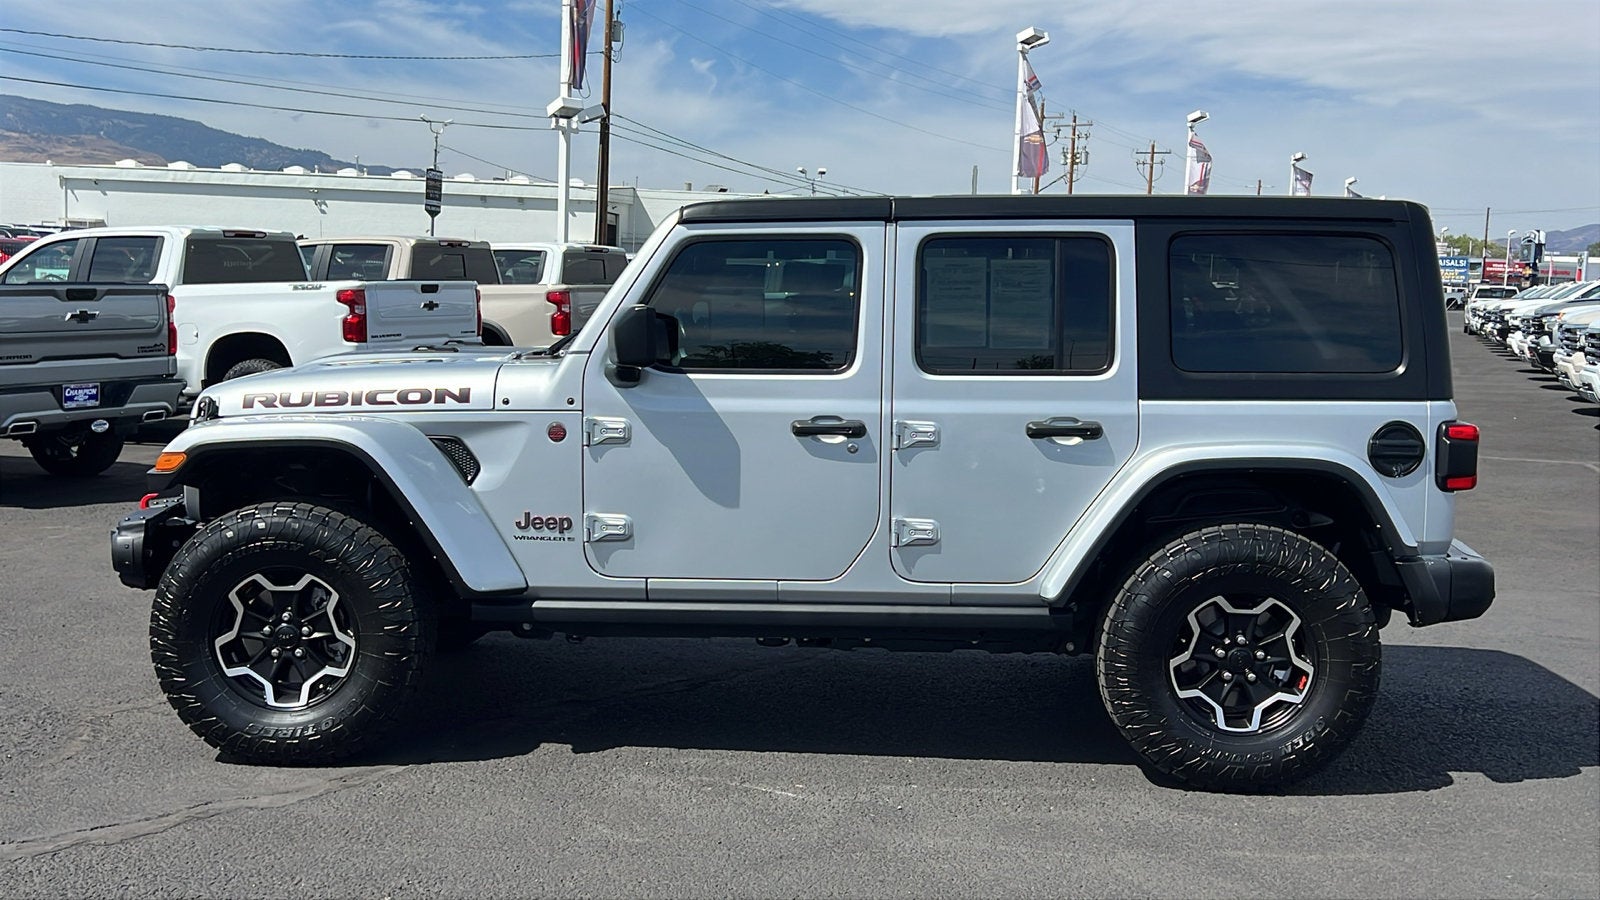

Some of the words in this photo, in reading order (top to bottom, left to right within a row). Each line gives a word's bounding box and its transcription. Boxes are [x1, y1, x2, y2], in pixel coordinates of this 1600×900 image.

[65, 388, 97, 397] CHAMPION
[242, 387, 471, 409] RUBICON
[515, 511, 573, 534] Jeep
